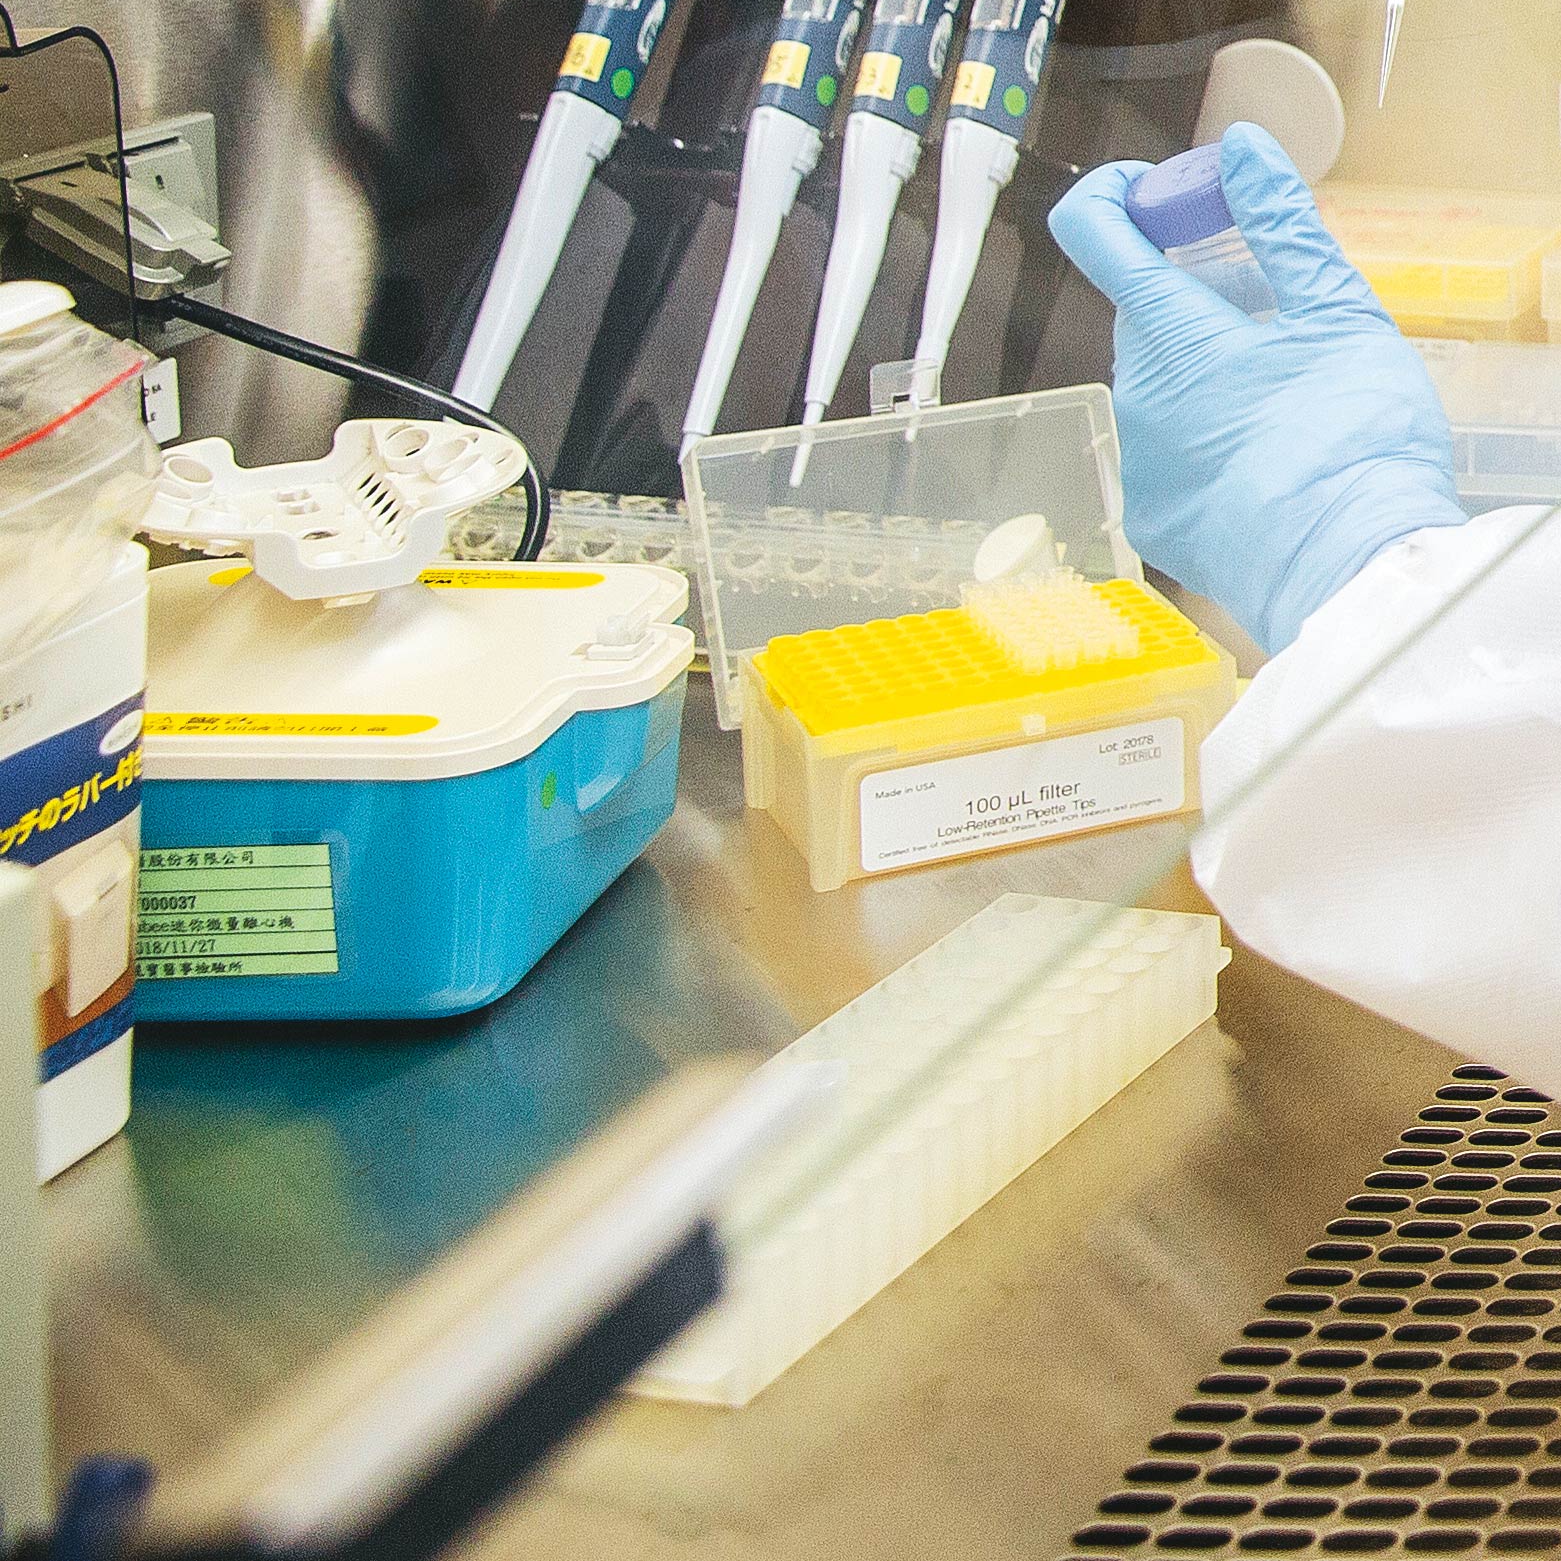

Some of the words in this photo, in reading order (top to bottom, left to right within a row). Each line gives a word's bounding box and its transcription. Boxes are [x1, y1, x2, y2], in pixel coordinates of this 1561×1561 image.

[875, 790, 902, 800] Made
[904, 787, 914, 795] in
[915, 781, 936, 792] USA
[965, 795, 1001, 816] 100
[1040, 781, 1081, 801] filter
[937, 812, 1022, 838] Low-Retention
[1026, 803, 1067, 820] Pipette
[1073, 797, 1097, 812] Tips
[140, 849, 255, 868] 股份有限公司
